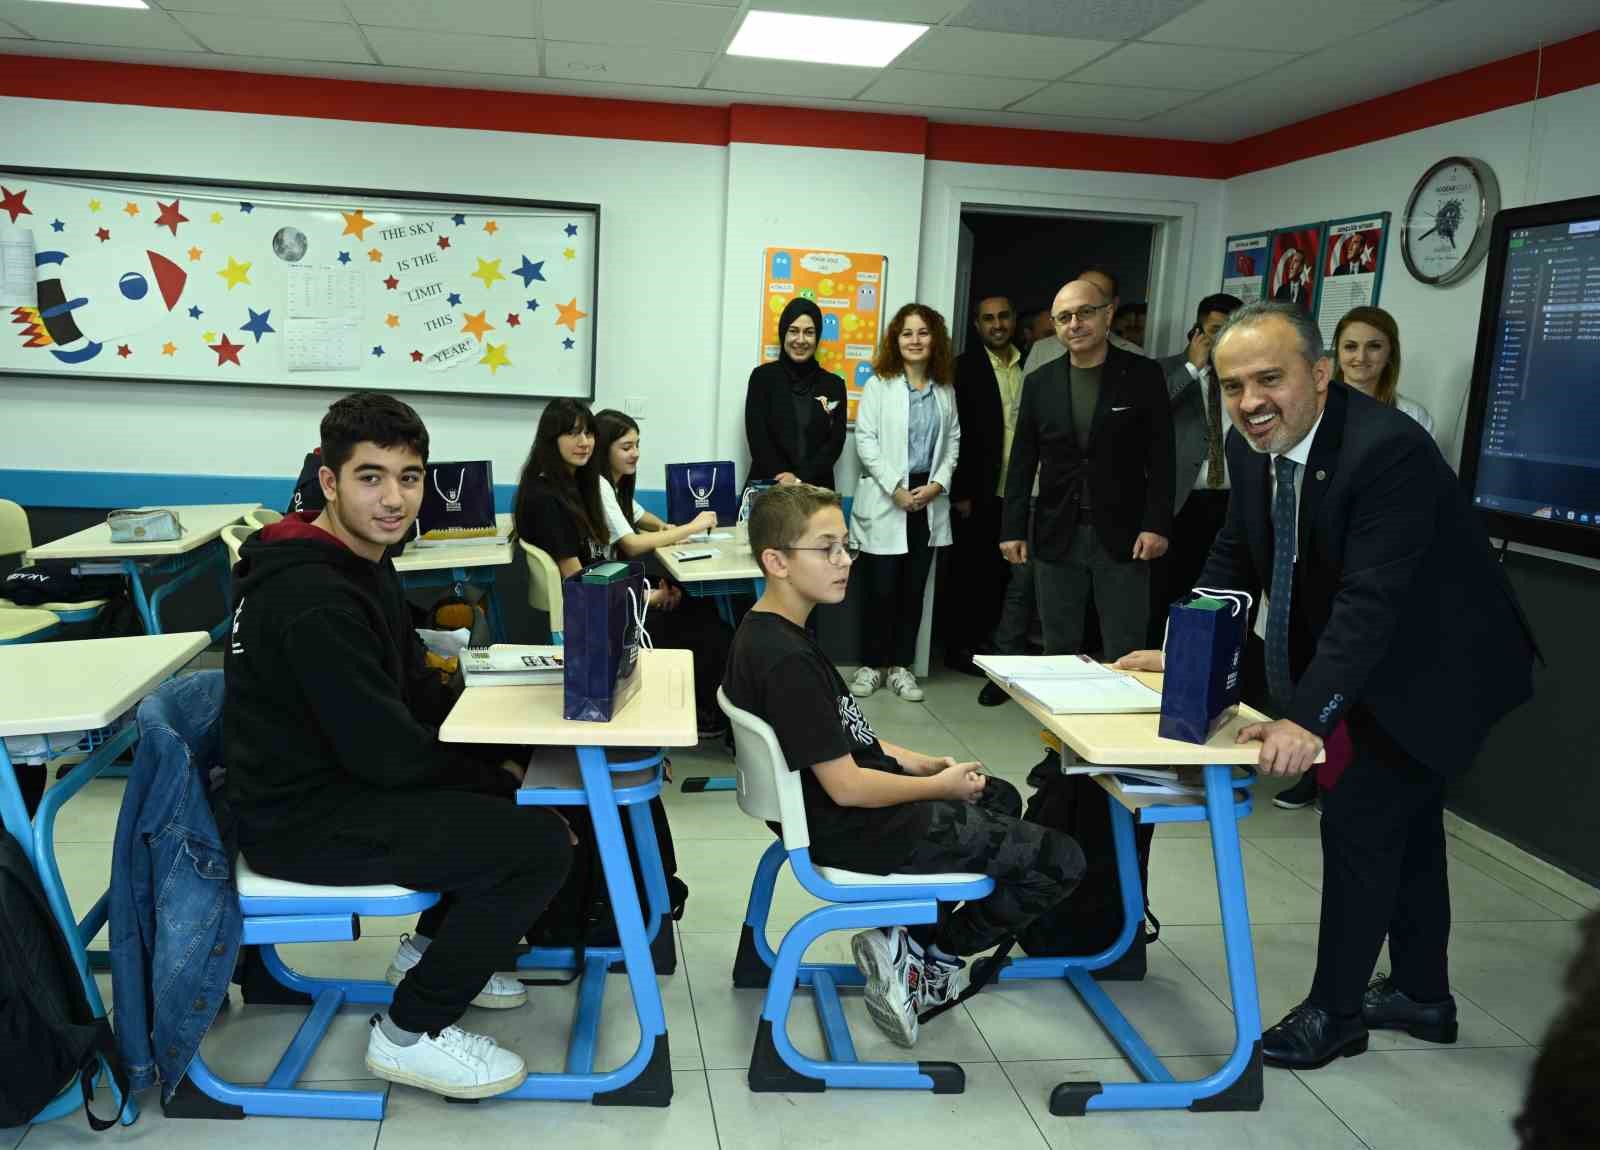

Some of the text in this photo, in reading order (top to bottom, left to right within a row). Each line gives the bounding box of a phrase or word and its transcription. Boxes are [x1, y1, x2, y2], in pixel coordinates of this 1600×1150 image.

[380, 221, 435, 241] THE SKY
[396, 252, 438, 272] IS THE
[407, 282, 443, 302] LIMIT
[423, 314, 453, 332] THIS
[432, 341, 470, 362] YEAR!
